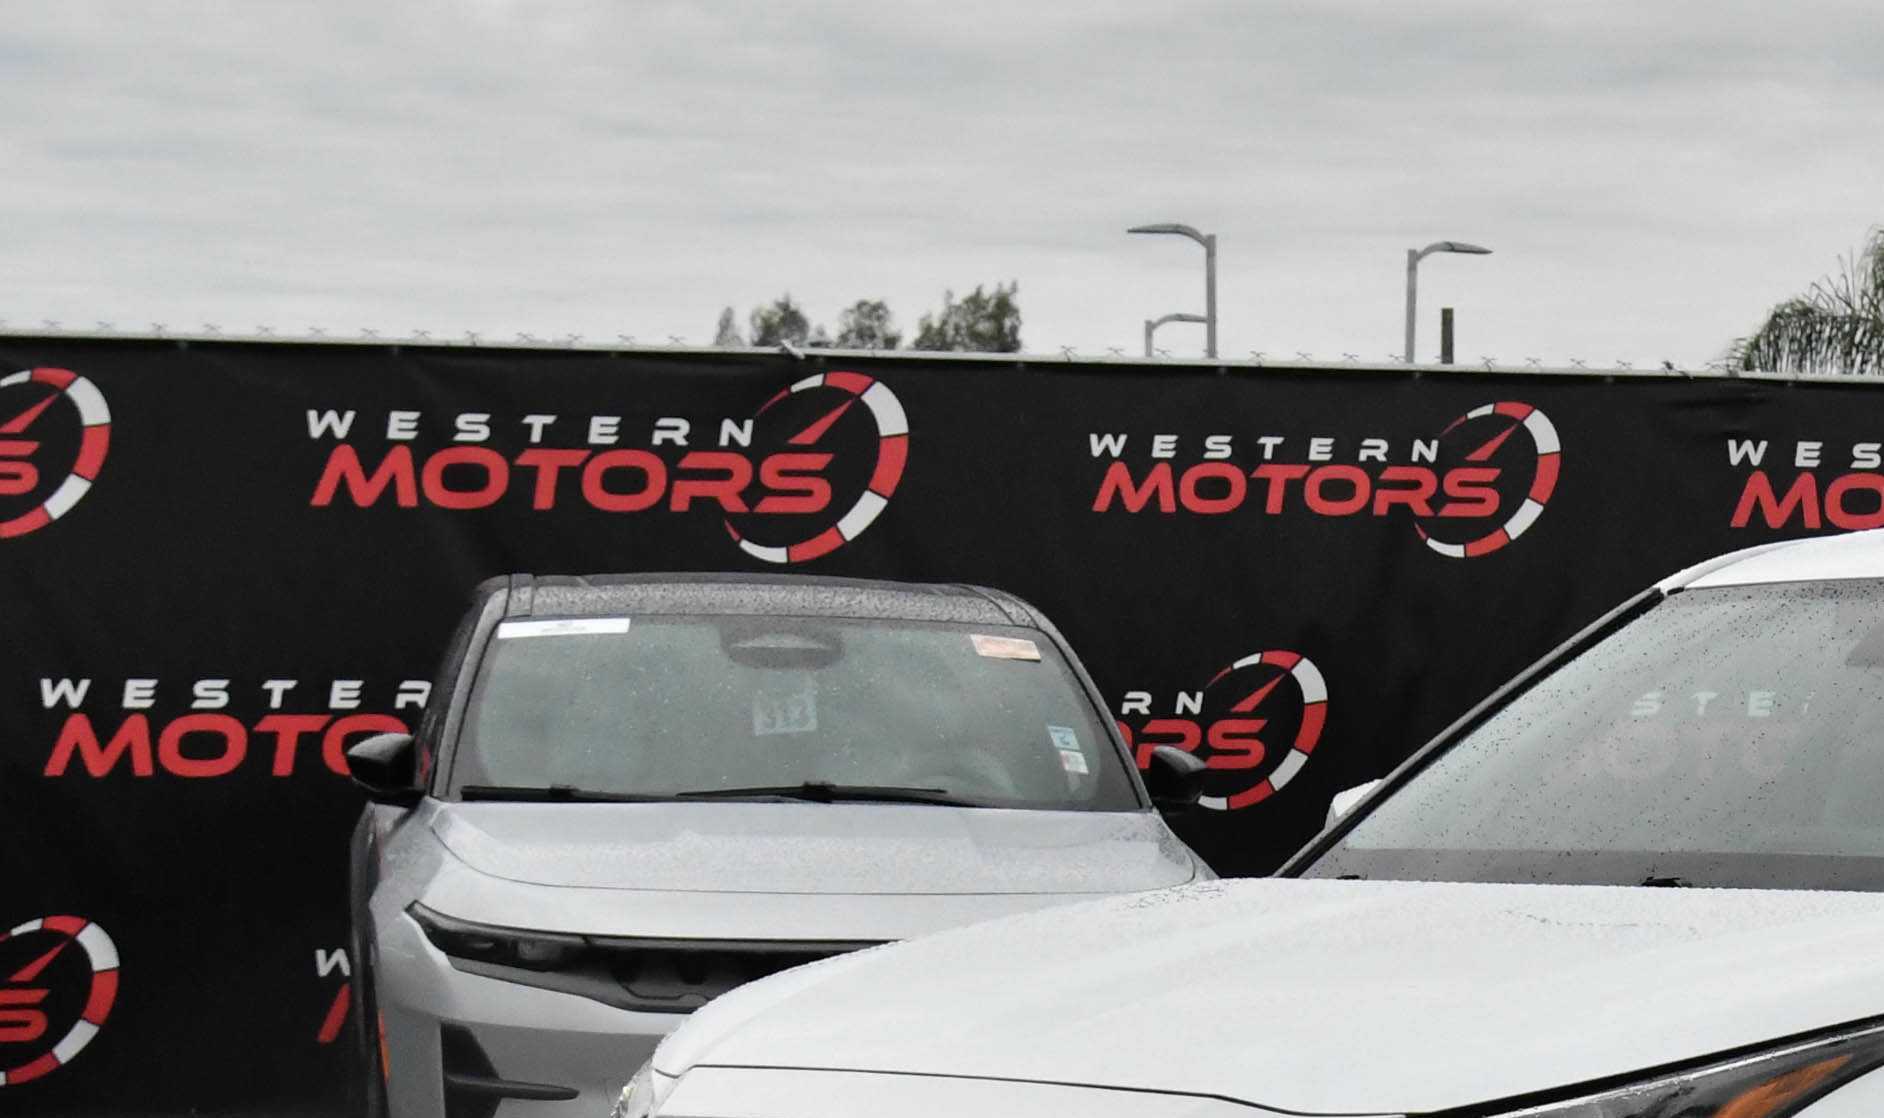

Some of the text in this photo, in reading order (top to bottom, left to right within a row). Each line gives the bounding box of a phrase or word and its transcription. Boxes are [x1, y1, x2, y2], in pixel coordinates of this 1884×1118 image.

[307, 409, 754, 447] WESTERN
[1089, 433, 1439, 463] WESTERN
[310, 445, 834, 514] MOTORS
[1092, 461, 1502, 518] MOTORS
[40, 678, 432, 709] WESTER
